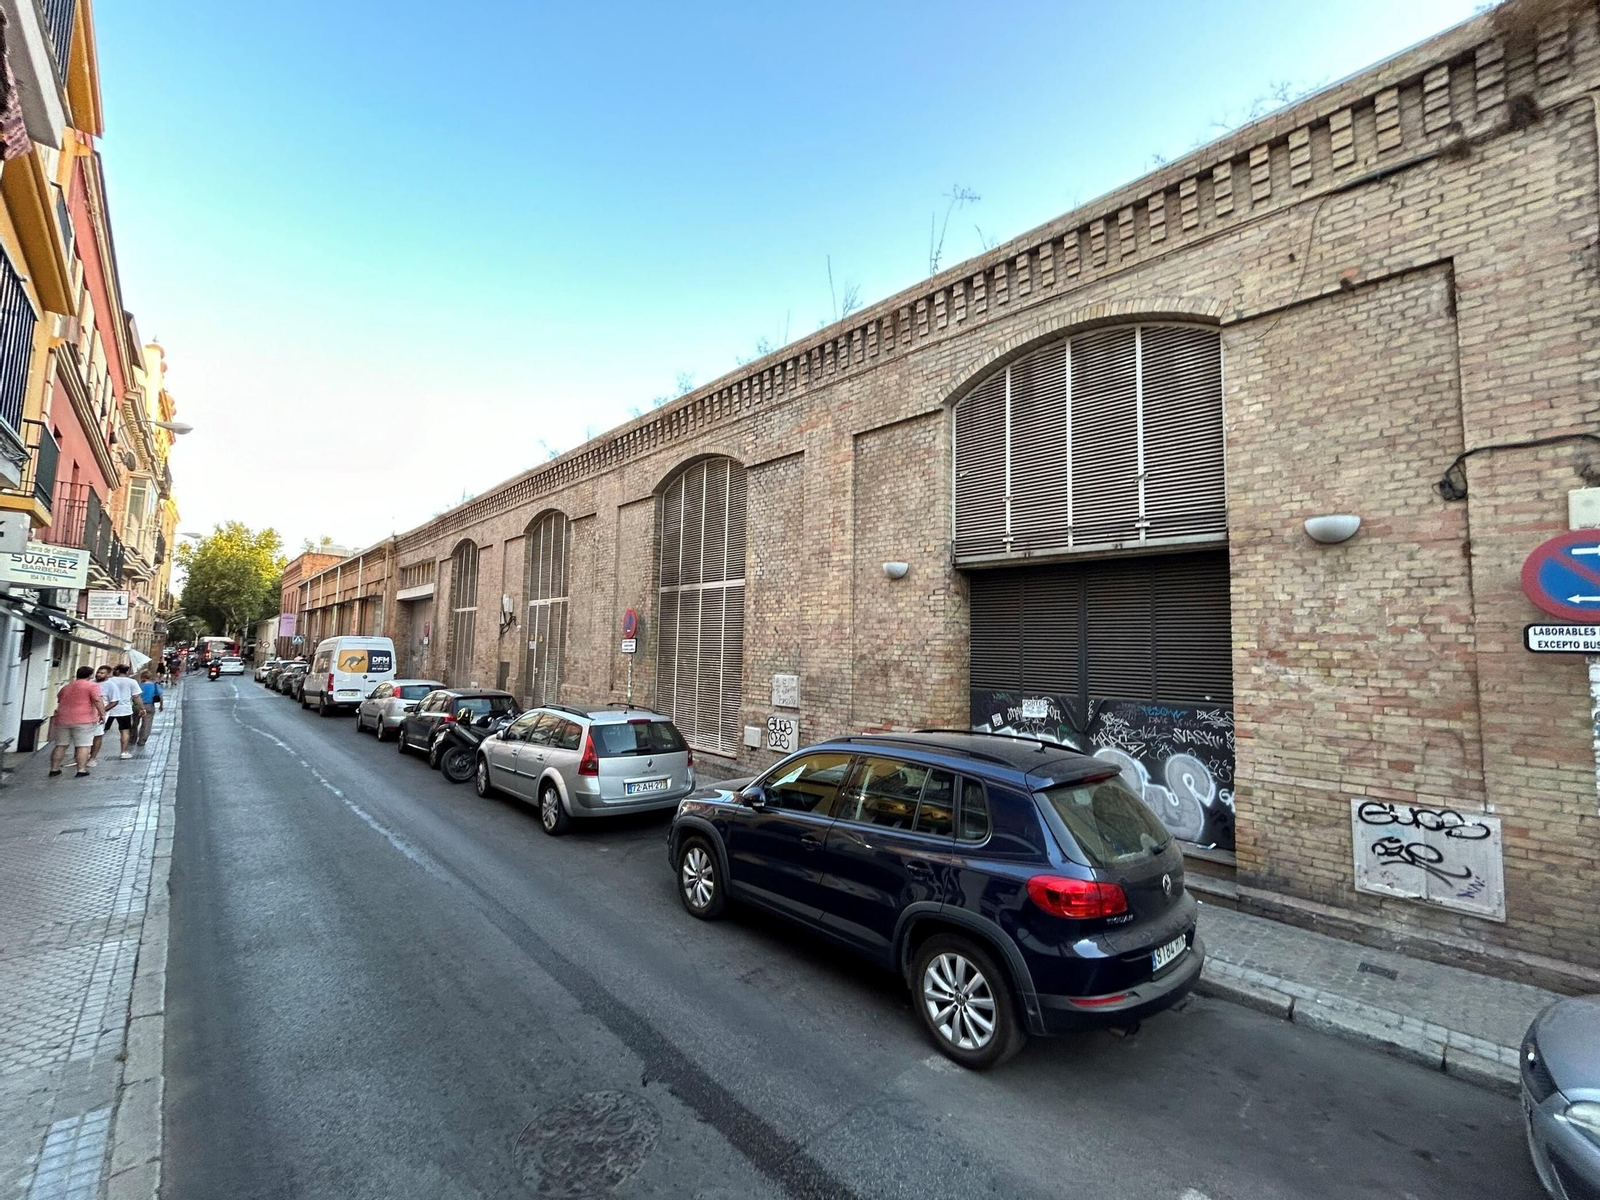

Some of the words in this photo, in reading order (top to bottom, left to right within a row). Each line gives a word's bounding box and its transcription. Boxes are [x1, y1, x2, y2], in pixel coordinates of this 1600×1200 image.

[11, 553, 78, 570] SUAREZ
[1533, 627, 1597, 636] LABORABLES
[1538, 640, 1580, 649] EXCEPTO
[1583, 641, 1600, 649] BUS
